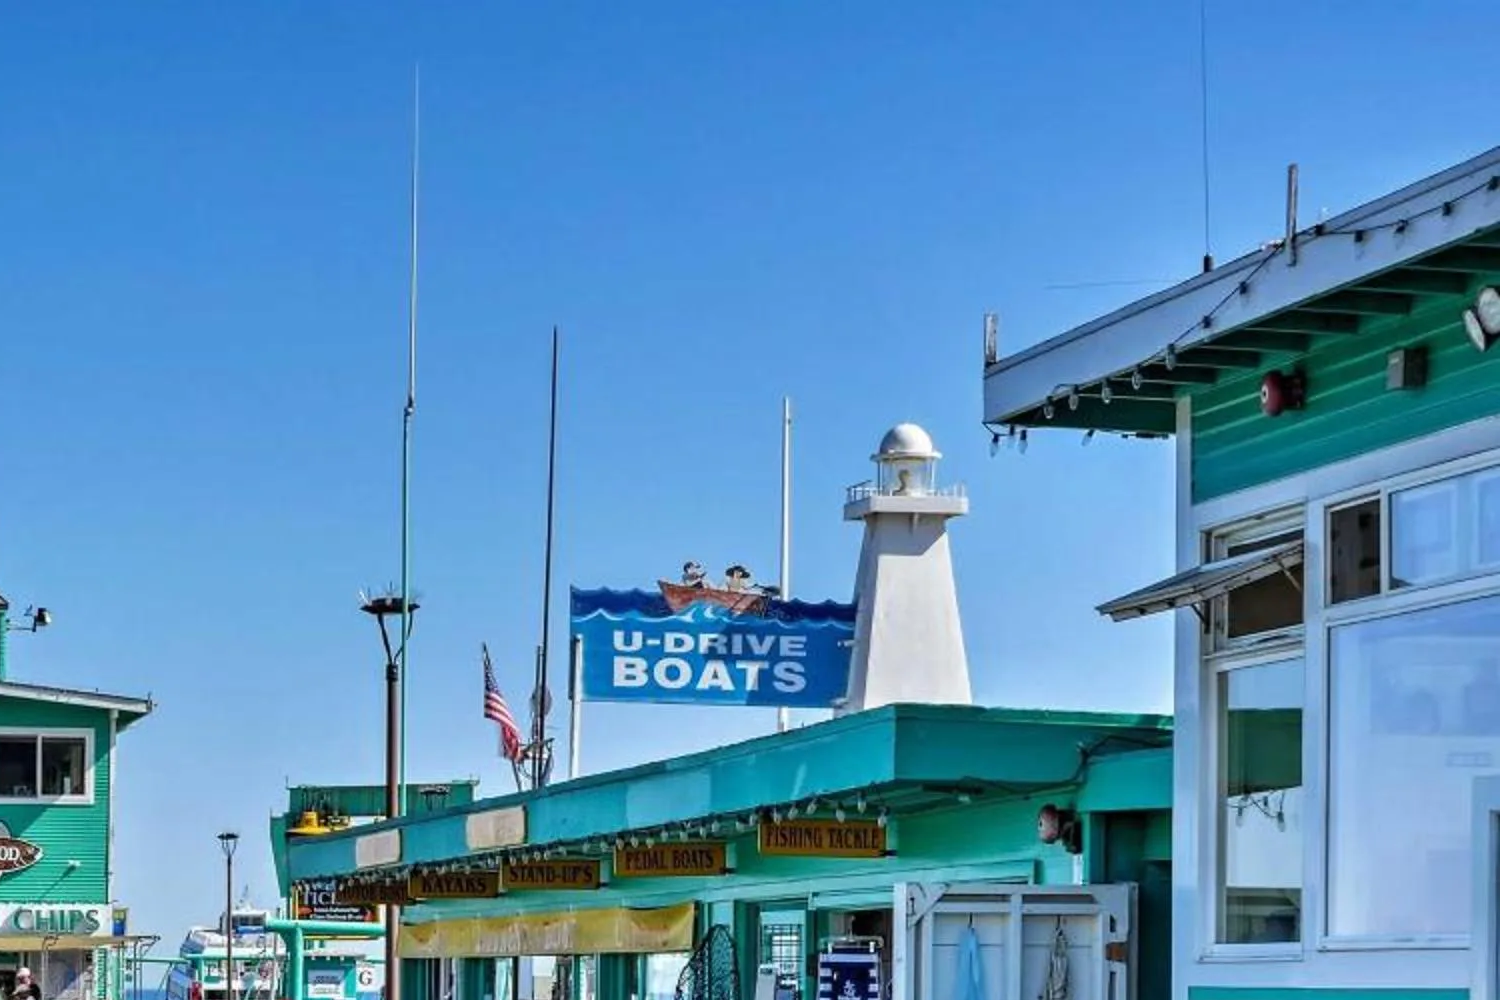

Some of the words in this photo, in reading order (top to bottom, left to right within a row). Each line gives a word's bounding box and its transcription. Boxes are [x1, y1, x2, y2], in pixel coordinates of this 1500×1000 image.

[612, 629, 807, 658] U-DRIVE
[612, 656, 807, 693] BOATS
[765, 825, 823, 849] FISHING
[828, 827, 880, 850] TACKLE
[625, 850, 666, 871] PEDAL
[673, 849, 714, 870] BOATS
[422, 875, 487, 894] KAYAKS
[13, 907, 101, 934] CHIPS
[359, 969, 373, 986] G
